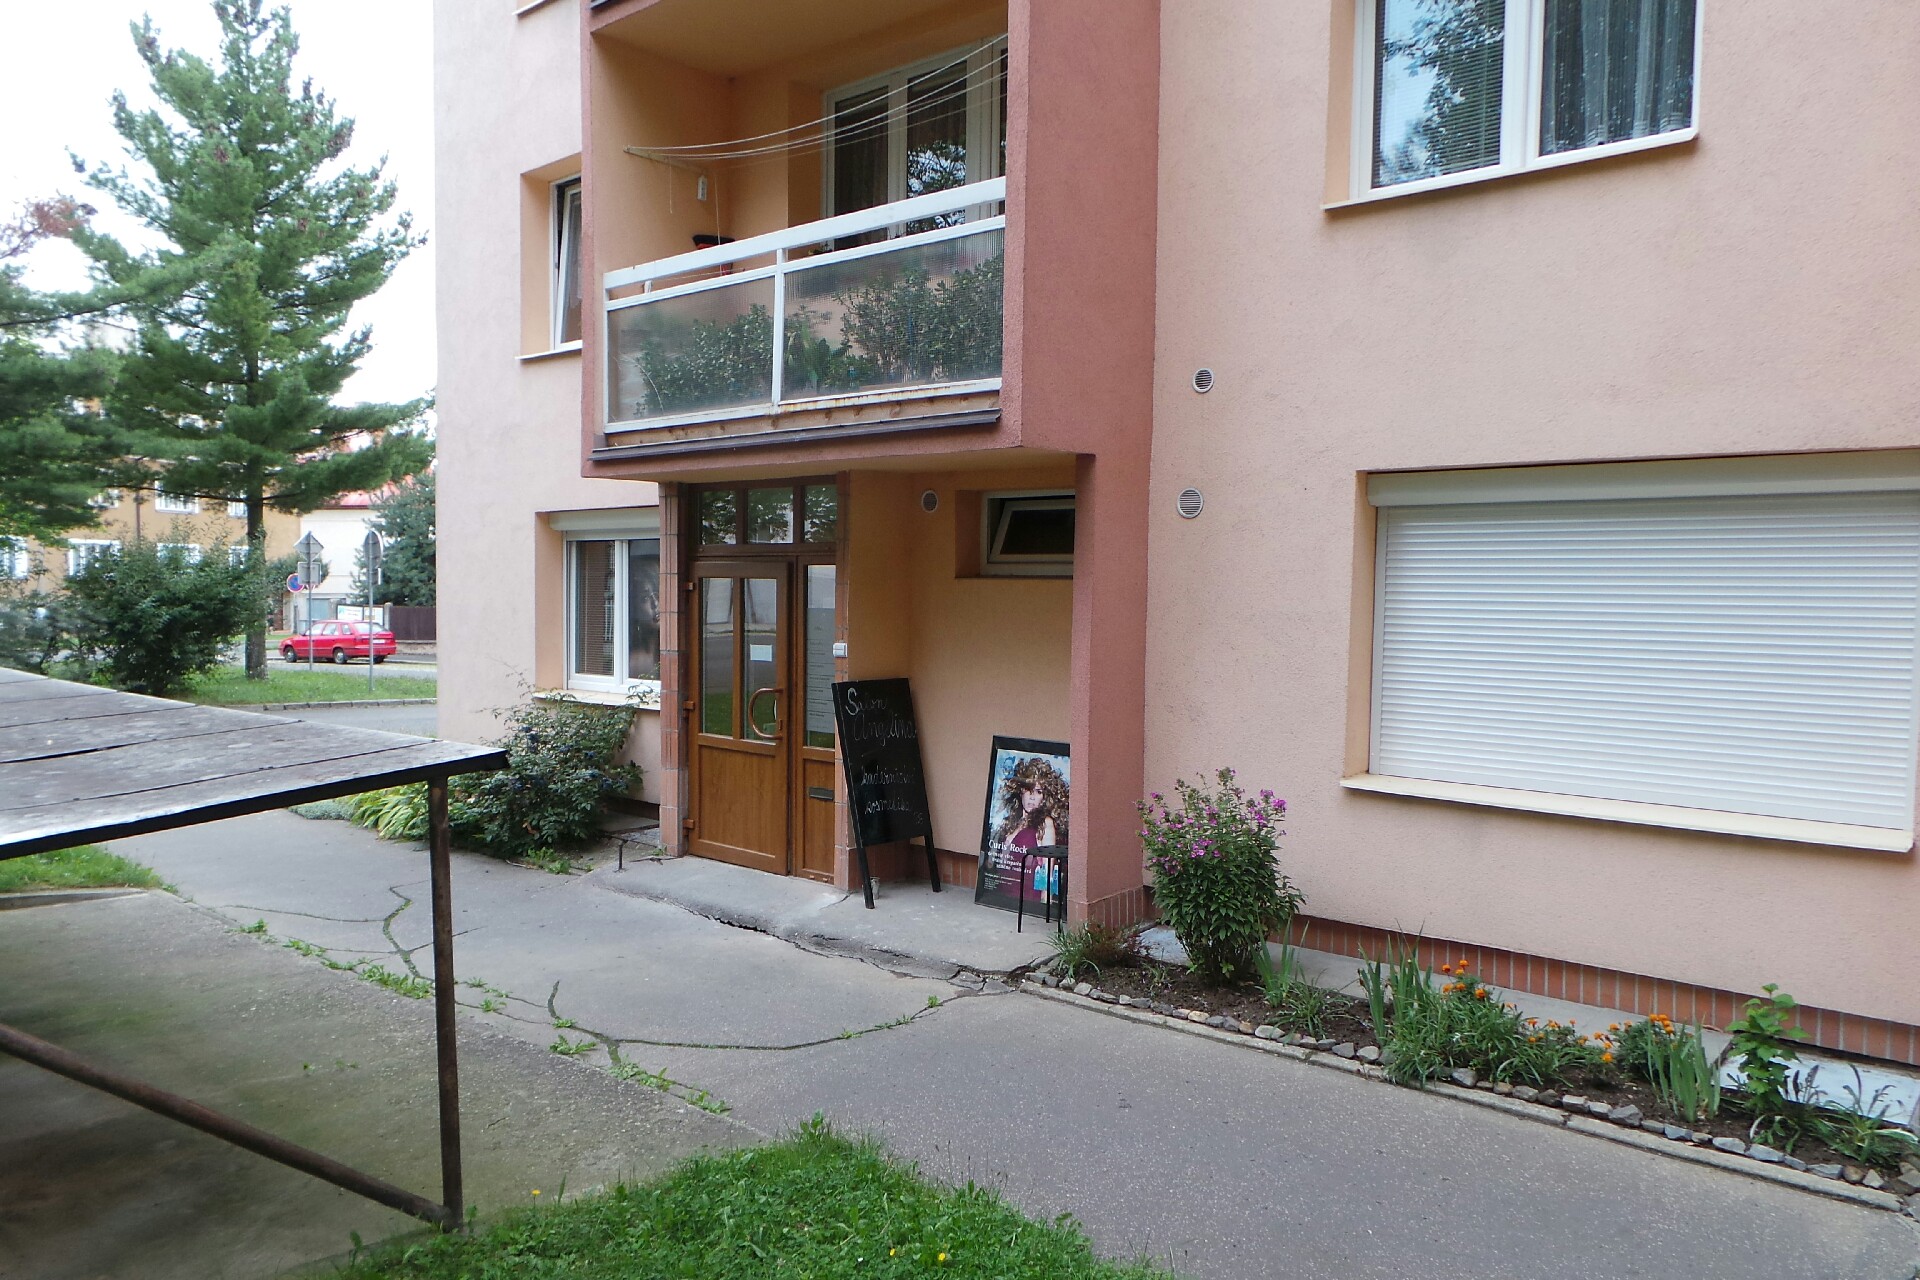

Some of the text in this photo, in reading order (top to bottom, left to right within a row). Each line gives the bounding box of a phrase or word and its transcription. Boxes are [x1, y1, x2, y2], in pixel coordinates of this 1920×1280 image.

[845, 687, 886, 716] Salon
[989, 840, 1028, 854] Curls Rock
